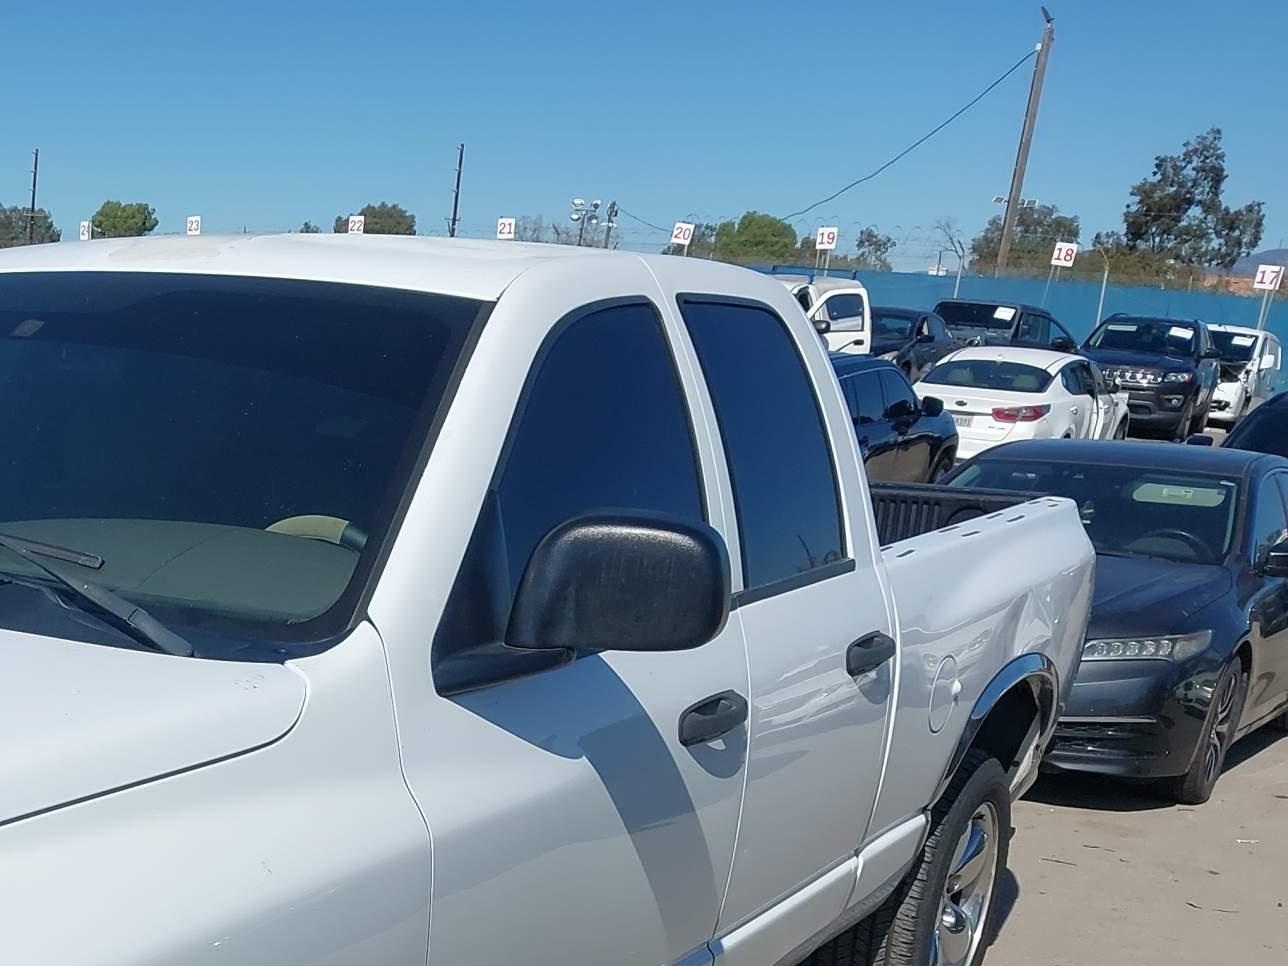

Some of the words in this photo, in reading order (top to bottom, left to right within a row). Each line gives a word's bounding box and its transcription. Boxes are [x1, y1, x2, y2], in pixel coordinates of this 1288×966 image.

[188, 219, 200, 231] 23
[350, 220, 363, 232] 22
[498, 222, 512, 234] 21
[674, 226, 691, 240] 20
[818, 231, 835, 245] 19
[1054, 247, 1074, 262] 18
[1256, 269, 1280, 285] 17
